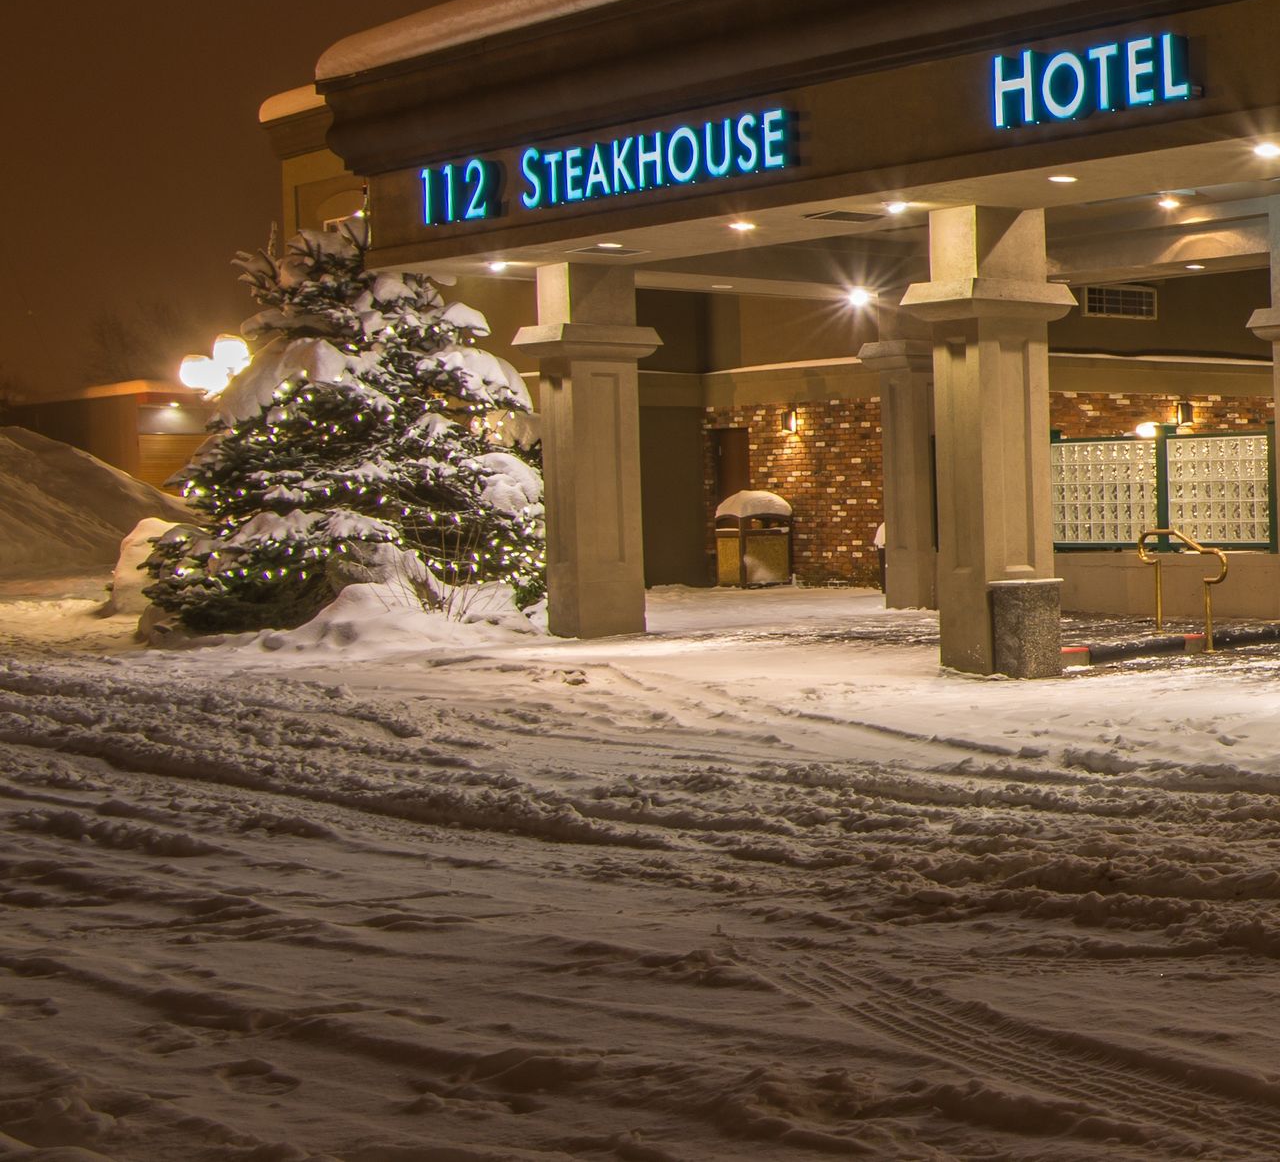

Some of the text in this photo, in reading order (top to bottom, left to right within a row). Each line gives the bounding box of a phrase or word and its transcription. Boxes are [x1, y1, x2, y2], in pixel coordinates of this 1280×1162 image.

[992, 33, 1189, 128] HOTEL
[420, 108, 785, 226] 112 STEAKHOUSE
